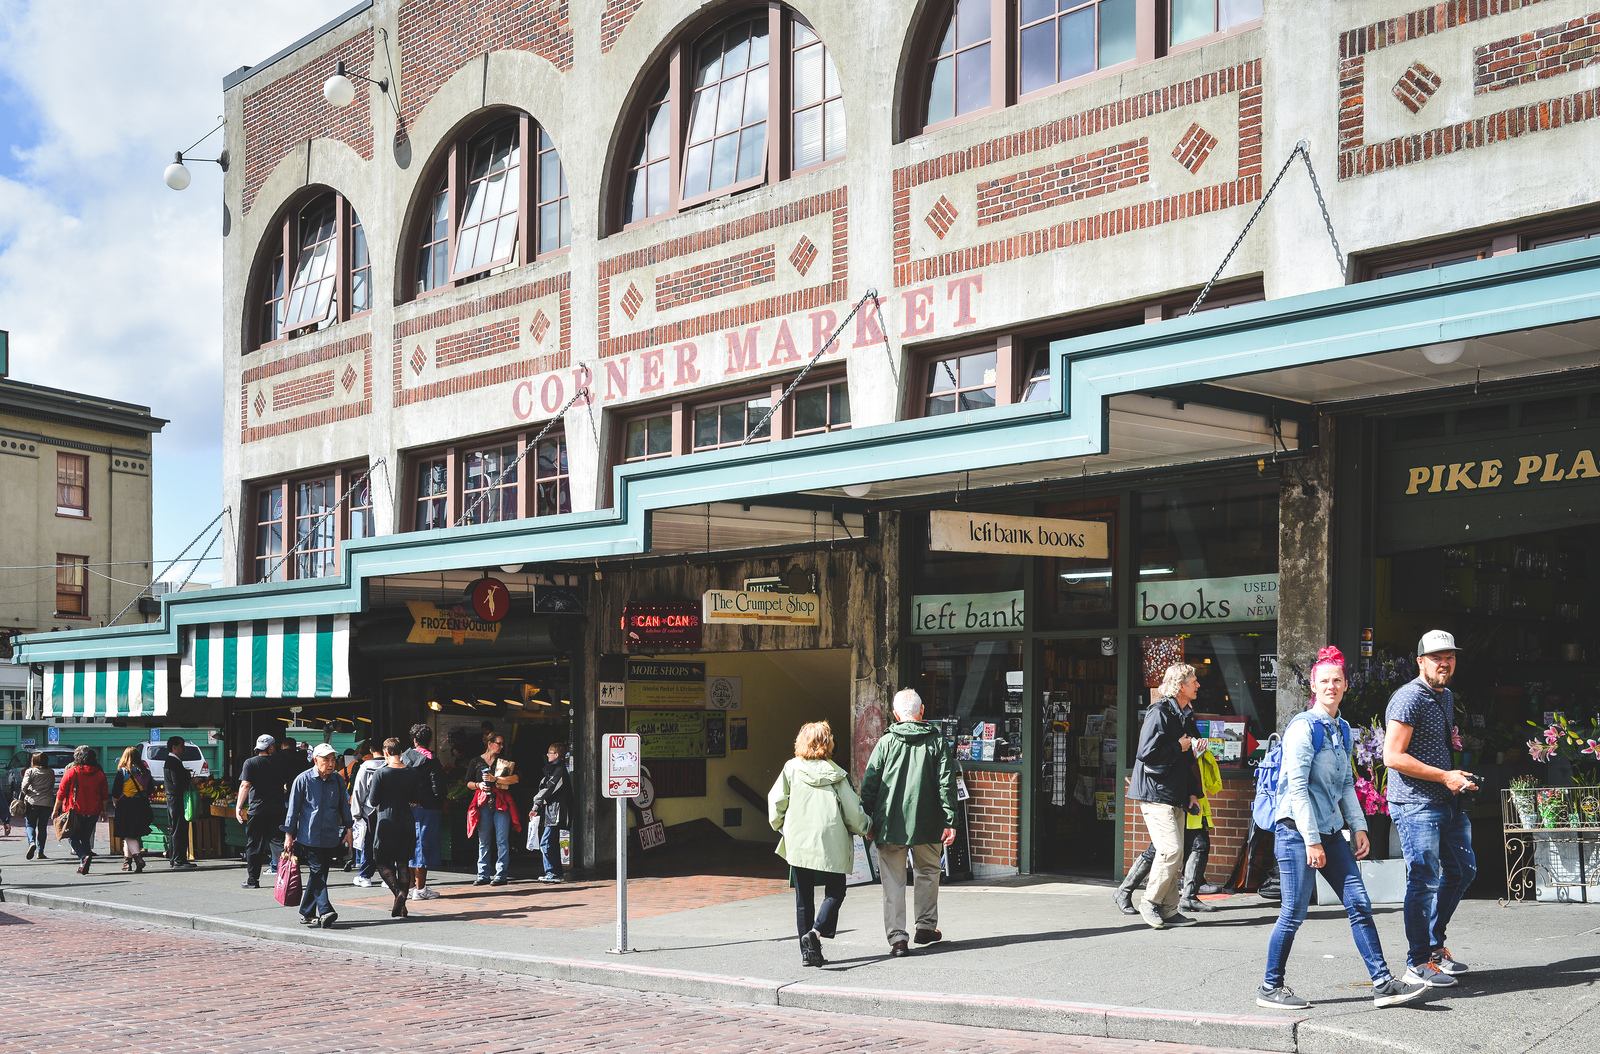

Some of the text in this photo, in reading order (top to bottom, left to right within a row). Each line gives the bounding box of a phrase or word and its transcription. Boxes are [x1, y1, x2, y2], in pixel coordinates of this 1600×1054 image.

[512, 274, 983, 420] CORNER MARKET
[1405, 449, 1600, 495] PIKE PLA
[994, 522, 1033, 544] bank
[1038, 526, 1085, 548] books
[1243, 581, 1277, 593] USED
[711, 593, 815, 616] The Crumpet Shop
[1140, 588, 1231, 621] books
[1256, 594, 1265, 604] &
[915, 599, 1024, 630] left bank
[1246, 605, 1277, 616] NEW
[420, 617, 461, 630] FROZEN
[637, 615, 689, 627] CAN CAN
[631, 665, 689, 676] MORE SHOPS
[611, 736, 626, 748] NO
